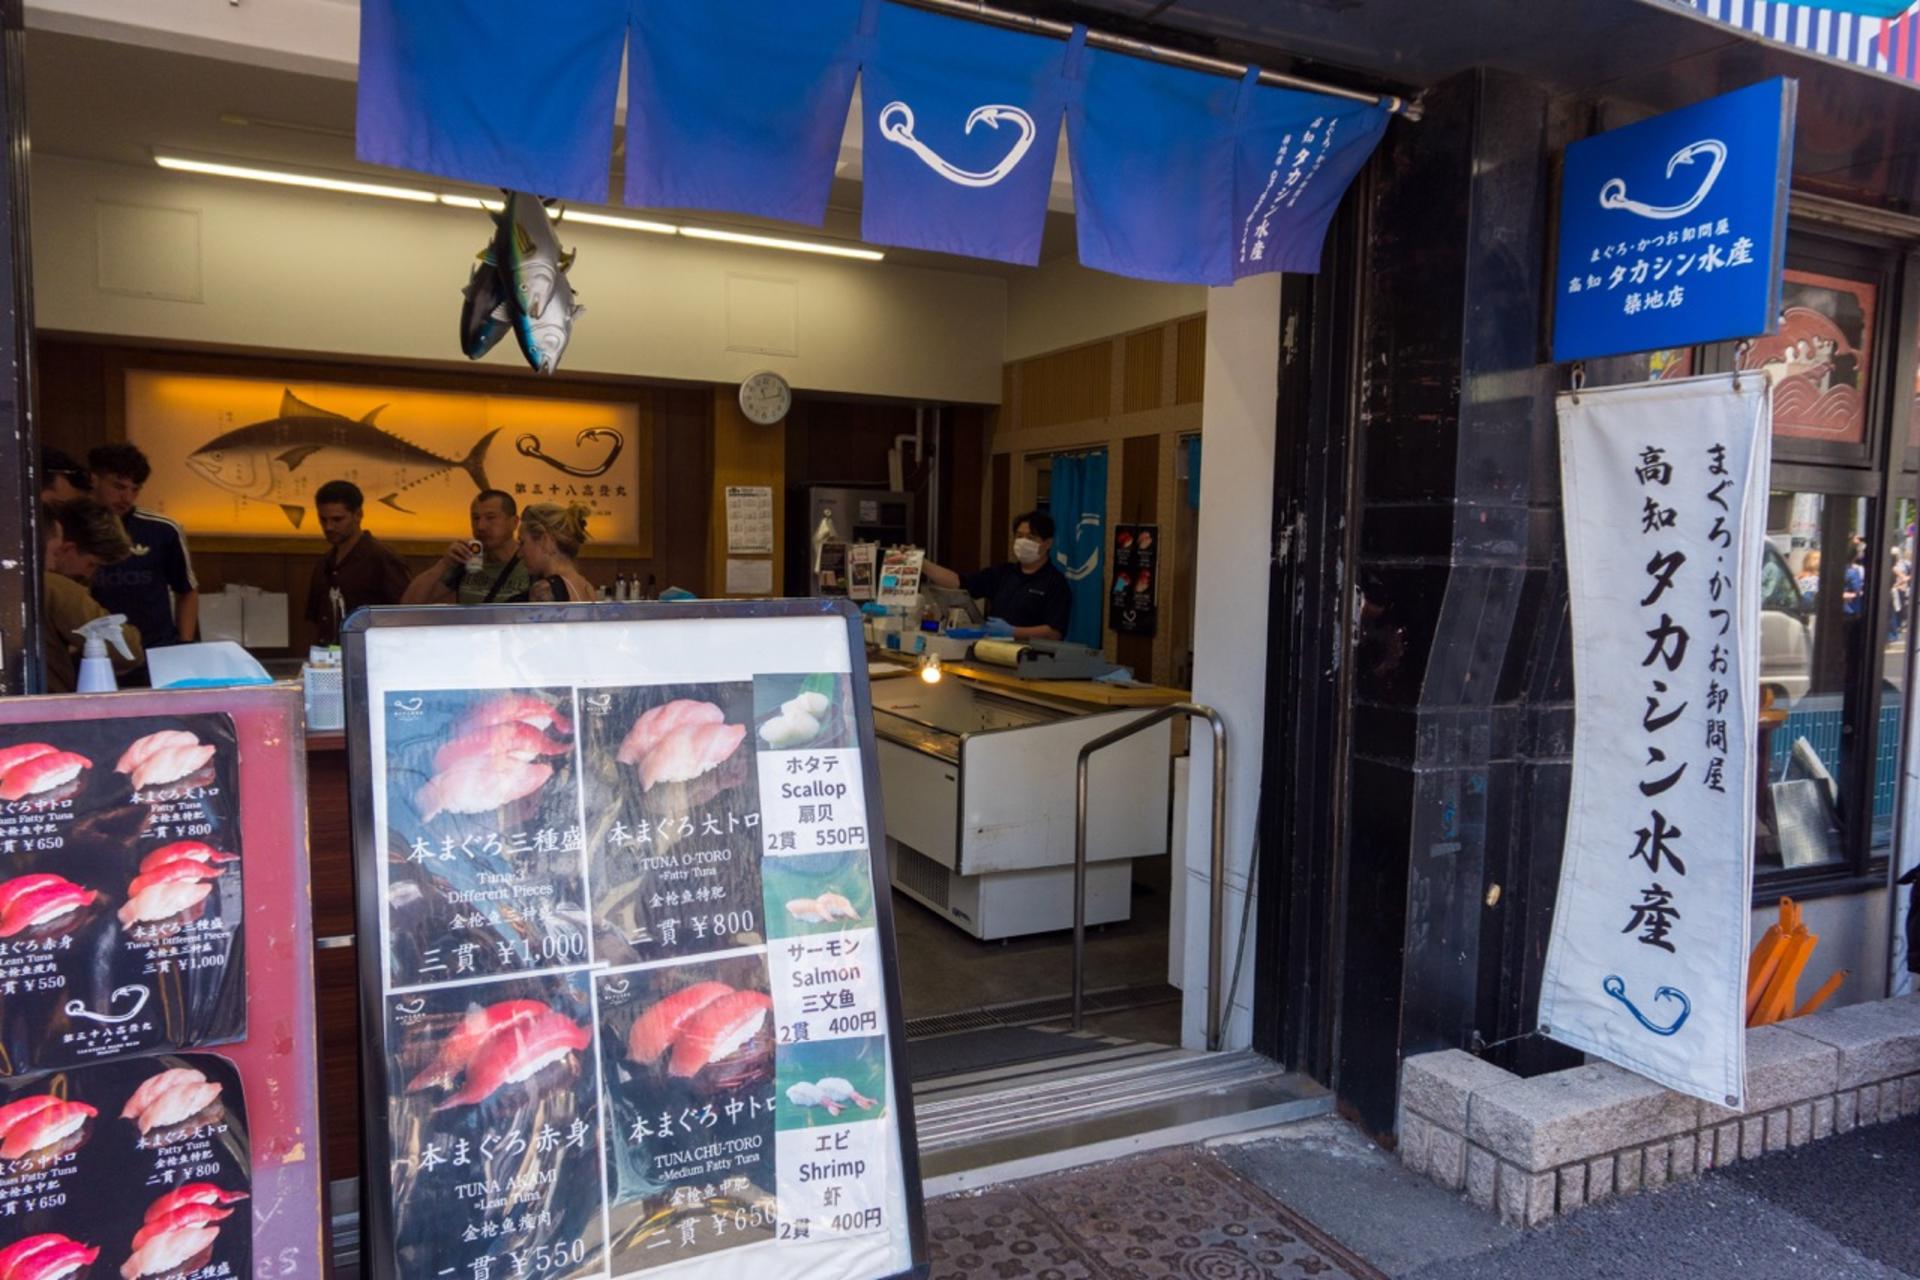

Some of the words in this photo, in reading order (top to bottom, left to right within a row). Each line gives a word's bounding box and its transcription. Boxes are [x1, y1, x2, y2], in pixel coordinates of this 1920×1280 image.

[1623, 284, 1686, 315] 築地店
[787, 756, 839, 774] ホタテ
[129, 787, 219, 805] 本まぐろ大トロ
[781, 780, 847, 799] Scallop
[151, 803, 175, 812] Fatty
[177, 802, 202, 811] Tuna
[798, 803, 834, 823] 扇贝
[19, 813, 45, 824] Fatty
[47, 812, 74, 821] Tuna
[608, 811, 760, 846] 本まぐろ大トロ
[176, 823, 212, 837] ¥800
[768, 831, 797, 850] 2貫
[816, 826, 865, 846] 550円
[23, 836, 64, 852] ¥650
[406, 825, 585, 864] 本まぐろ三種盛
[641, 856, 679, 871] TUNA
[682, 849, 732, 865] O-TORO
[691, 867, 717, 878] Tuna
[448, 888, 509, 904] Different
[512, 884, 554, 898] Pieces
[691, 910, 754, 939] ¥800
[125, 941, 151, 950] Tuna
[418, 942, 480, 973] 三貫
[497, 932, 585, 965] ¥1,000
[788, 938, 860, 962] サーモン
[26, 953, 54, 963] Tuna
[24, 974, 66, 992] ¥550
[792, 966, 861, 987] Salmon
[802, 988, 856, 1013] 三文鱼
[780, 1021, 810, 1042] 2貫
[829, 1011, 877, 1034] 400円
[136, 1124, 228, 1150] 本まぐろ大トロ
[417, 1117, 589, 1172] 本まぐろ赤身
[815, 1129, 851, 1152] エビ
[158, 1145, 183, 1156] Fatty
[185, 1140, 210, 1151] Tuna
[654, 1150, 692, 1168] TUNA
[694, 1135, 763, 1161] CHU-TORO
[183, 1162, 220, 1180] ¥800
[706, 1158, 733, 1172] Fatty
[734, 1153, 760, 1165] Tuna
[799, 1159, 866, 1182] Shrimp
[20, 1172, 48, 1183] Fatty
[50, 1166, 78, 1177] Tuna
[454, 1180, 500, 1199] TUNA
[823, 1186, 842, 1207] 虾
[24, 1193, 67, 1212] ¥650
[645, 1217, 701, 1248] 二貫
[780, 1217, 811, 1240] 2貫
[831, 1207, 881, 1232] 400円
[510, 1238, 585, 1275] ¥550
